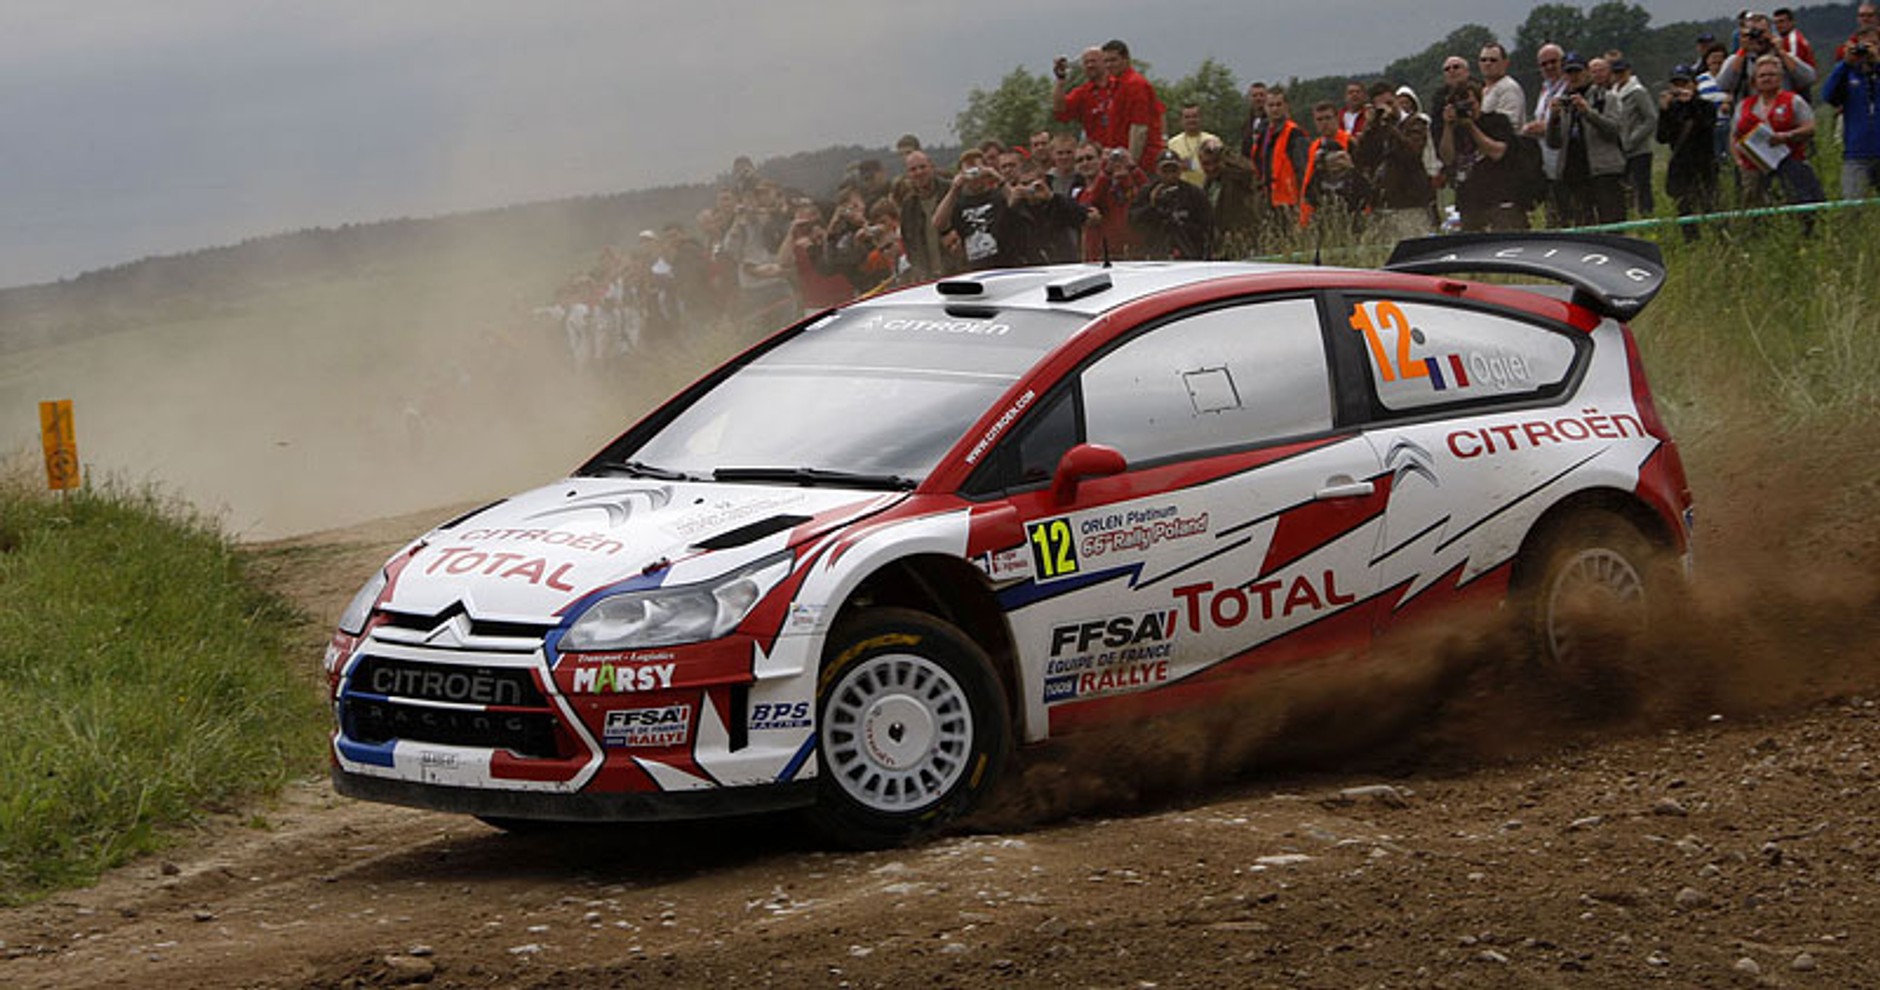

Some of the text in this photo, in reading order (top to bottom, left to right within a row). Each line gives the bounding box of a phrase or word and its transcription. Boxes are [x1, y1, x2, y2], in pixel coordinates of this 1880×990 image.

[1349, 300, 1429, 382] 12
[1446, 408, 1647, 459] CITROËN
[1081, 506, 1178, 535] ORLEN Platinum
[1112, 527, 1150, 550] Rally
[1152, 513, 1208, 543] Poland
[1031, 520, 1075, 576] 12
[425, 547, 574, 591] TOTAL
[1173, 570, 1355, 633] TOTAL
[1051, 610, 1165, 656] FFSA
[1098, 651, 1117, 667] DE
[1121, 642, 1171, 661] FRANCE
[573, 663, 676, 694] MARSY
[1079, 660, 1169, 693] RALLYE
[608, 709, 680, 726] FFSA
[752, 702, 809, 721] BPS
